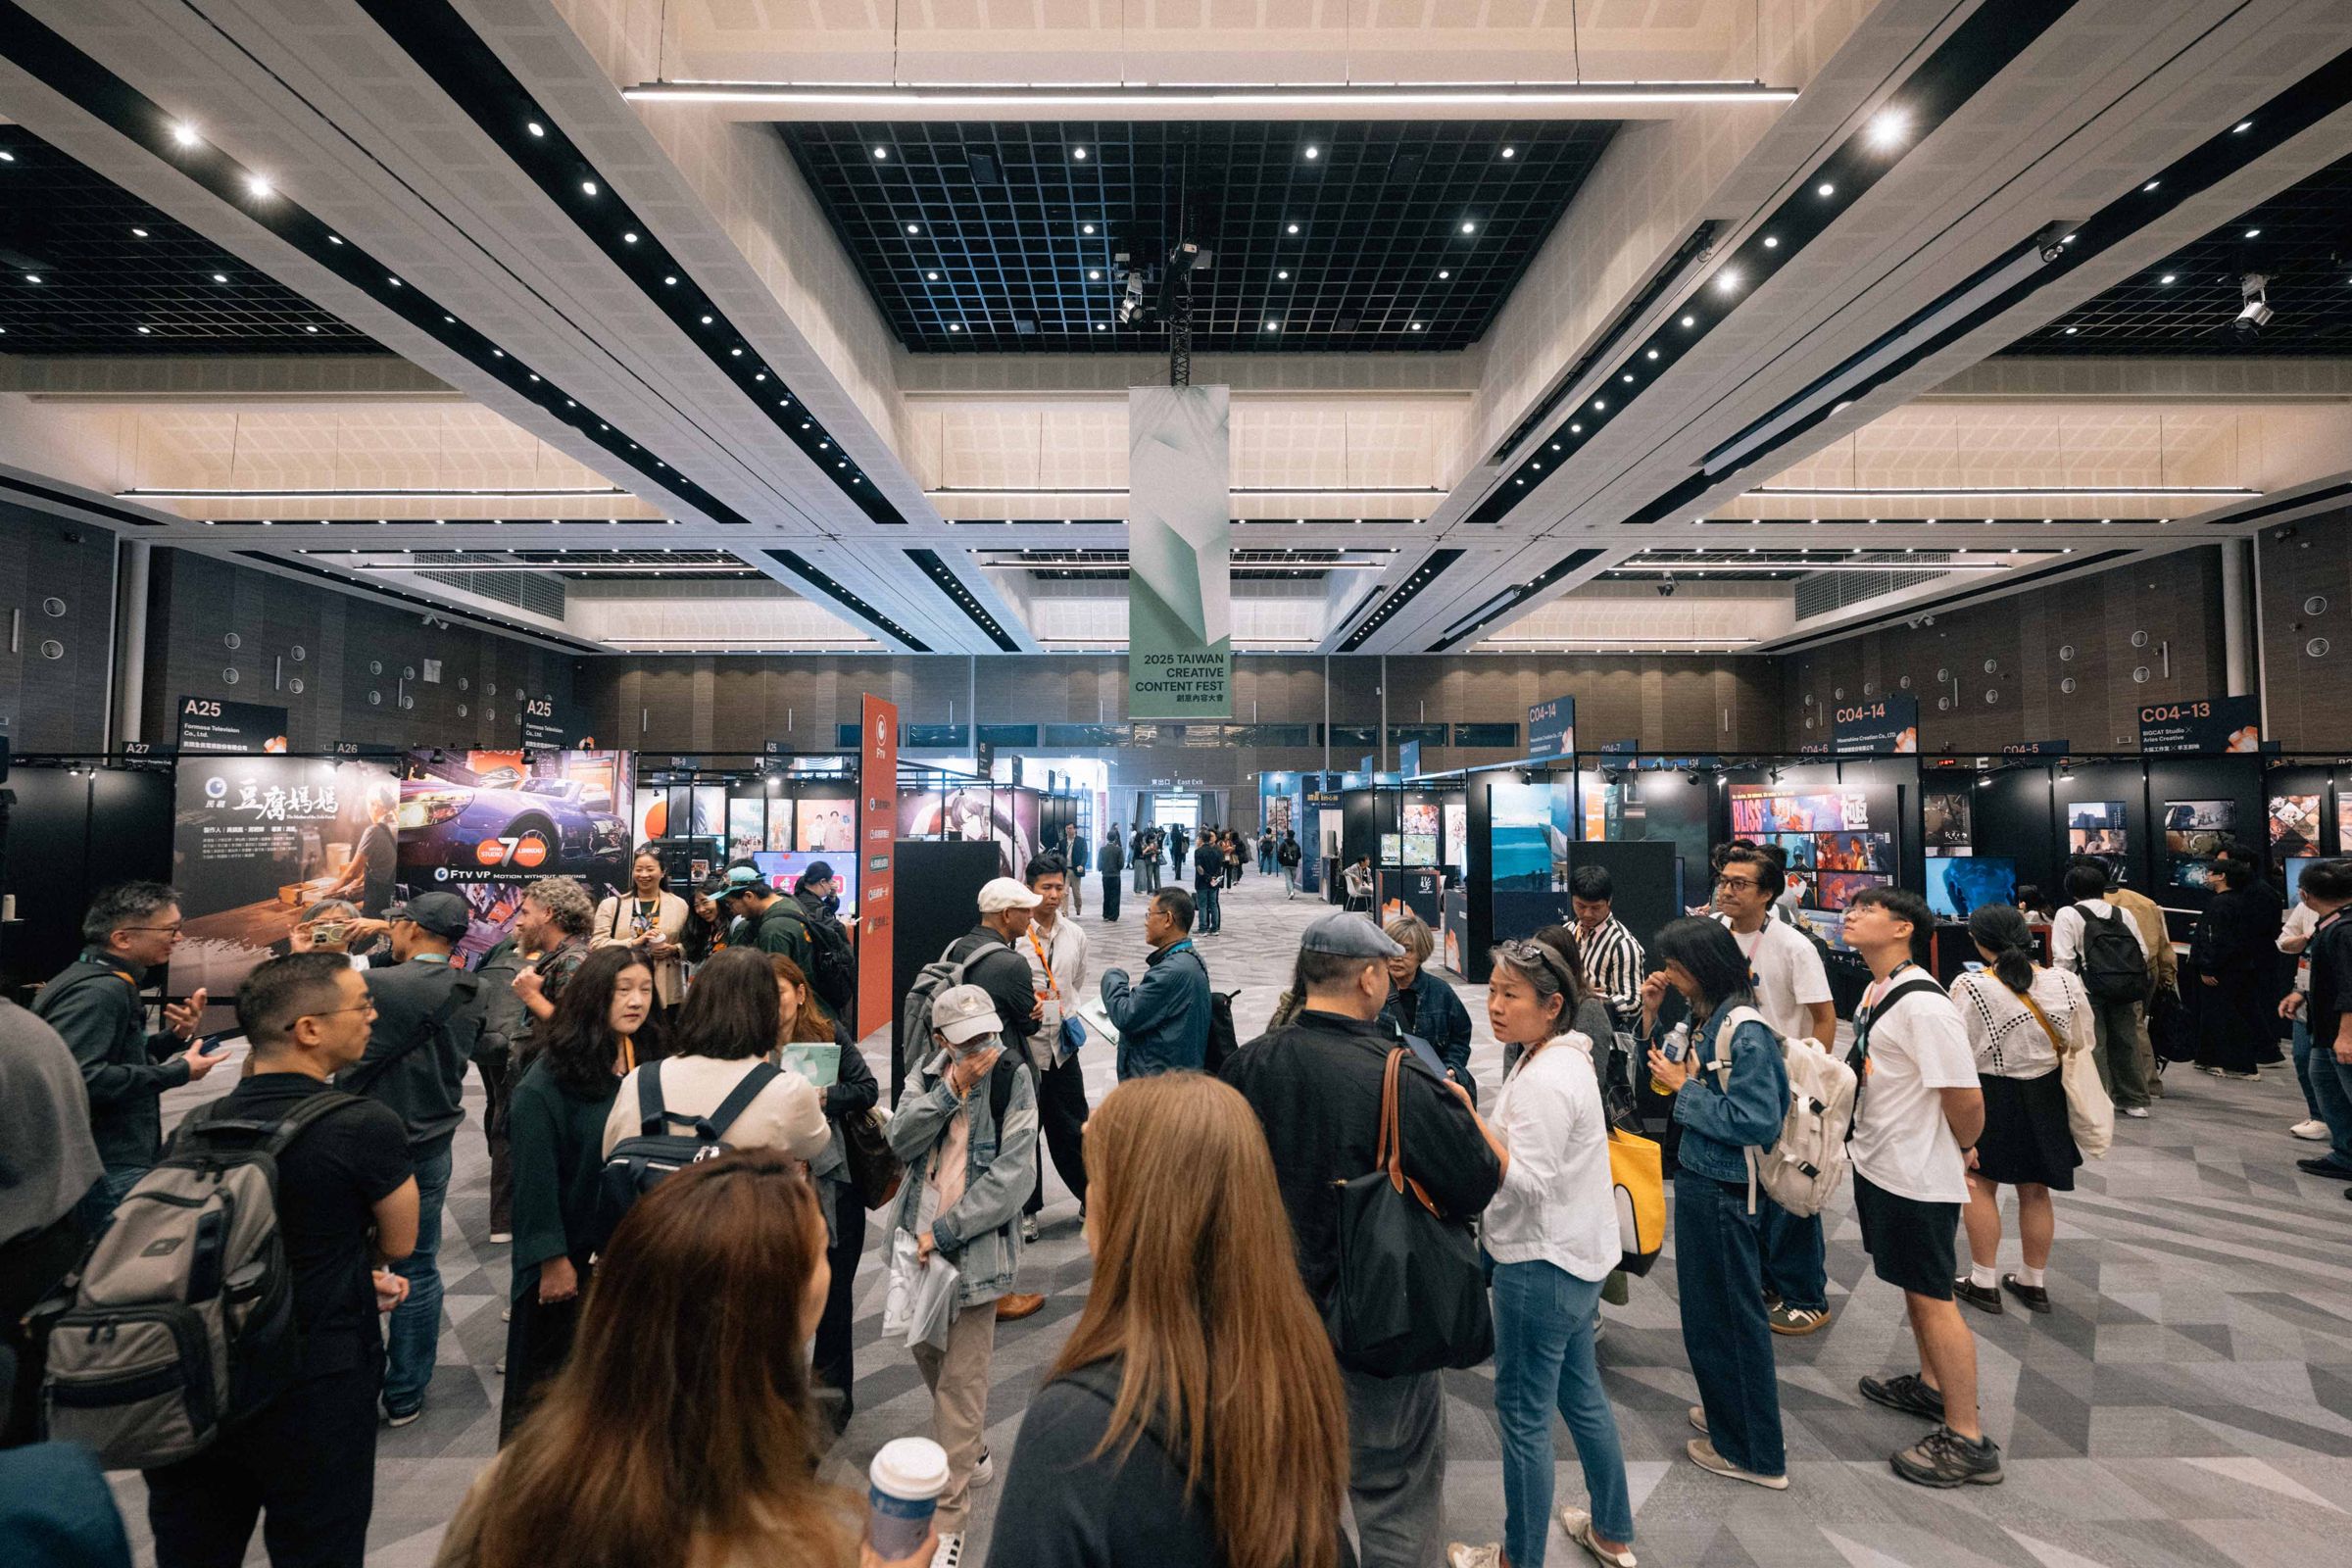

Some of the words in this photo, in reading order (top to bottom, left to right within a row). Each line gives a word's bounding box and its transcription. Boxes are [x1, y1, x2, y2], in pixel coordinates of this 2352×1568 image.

[1145, 655, 1174, 664] 2025
[1177, 654, 1223, 664] TAIWAN
[1166, 667, 1224, 677] CREATIVE
[1136, 681, 1193, 692] CONTENT
[1196, 681, 1224, 691] FEST
[184, 700, 221, 717] A25
[527, 699, 552, 717] A25
[126, 743, 150, 754] A27
[337, 743, 359, 754] A26
[231, 778, 340, 821] 豆腐媽媽
